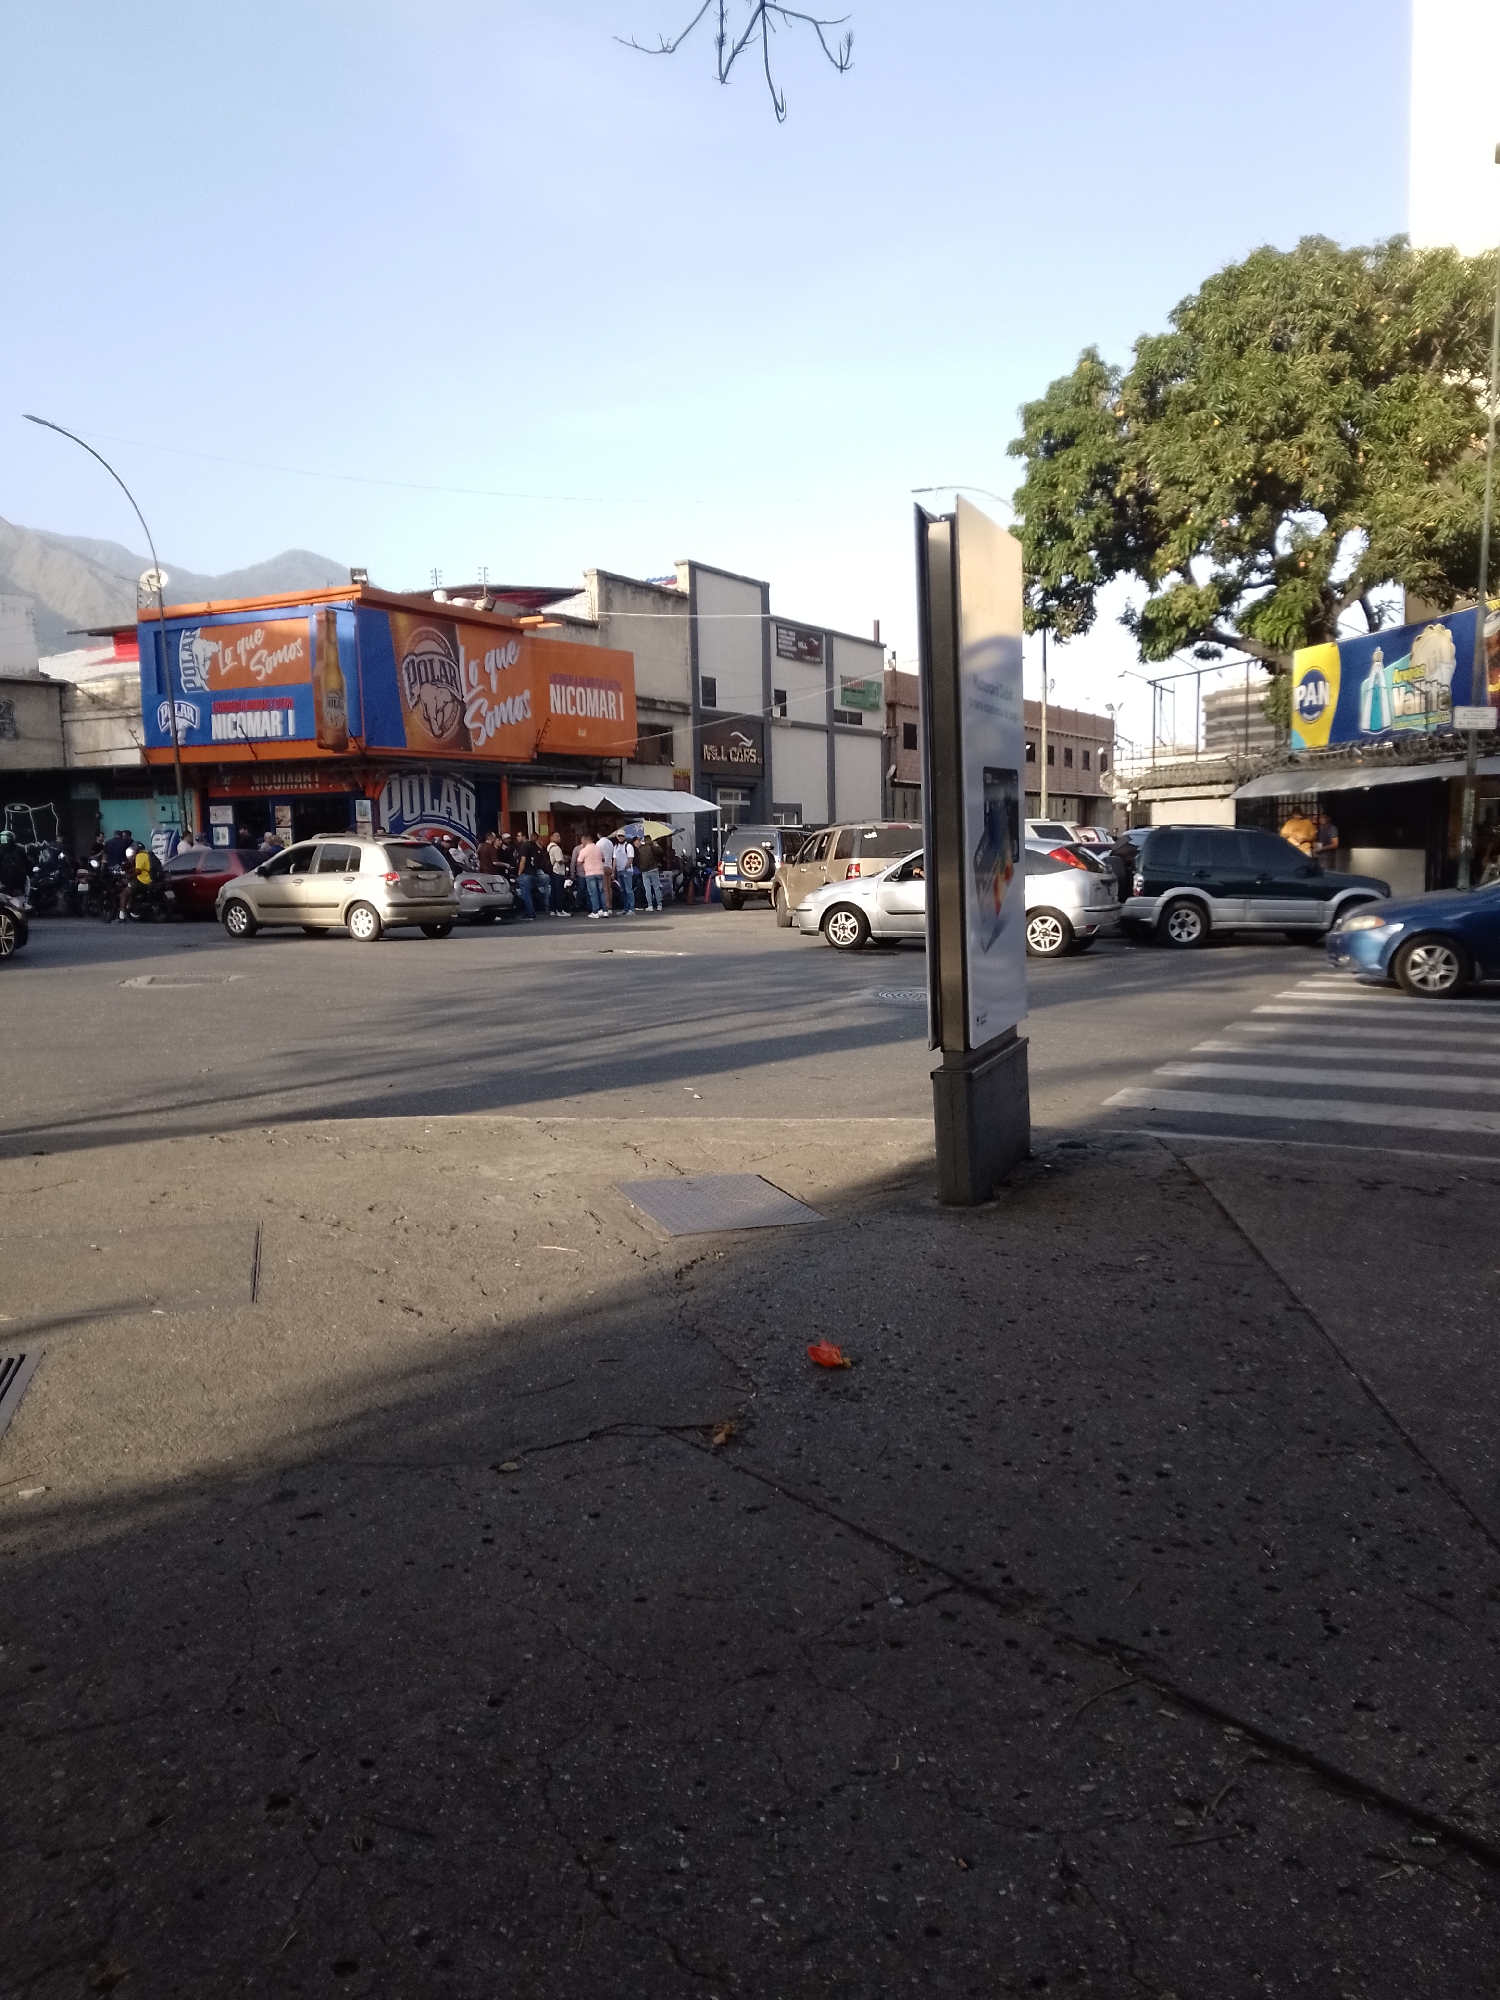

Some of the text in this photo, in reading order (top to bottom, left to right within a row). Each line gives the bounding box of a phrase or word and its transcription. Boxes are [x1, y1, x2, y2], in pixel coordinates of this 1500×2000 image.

[218, 628, 264, 675] Lo que
[250, 638, 303, 680] Somos
[459, 645, 486, 701] Lo
[485, 640, 520, 693] que
[405, 658, 460, 699] POLAR
[1294, 681, 1330, 709] PAN
[464, 690, 531, 746] Somos
[550, 684, 617, 720] NICOMAR
[211, 710, 283, 740] NICOMAR
[379, 773, 477, 838] POLAR
